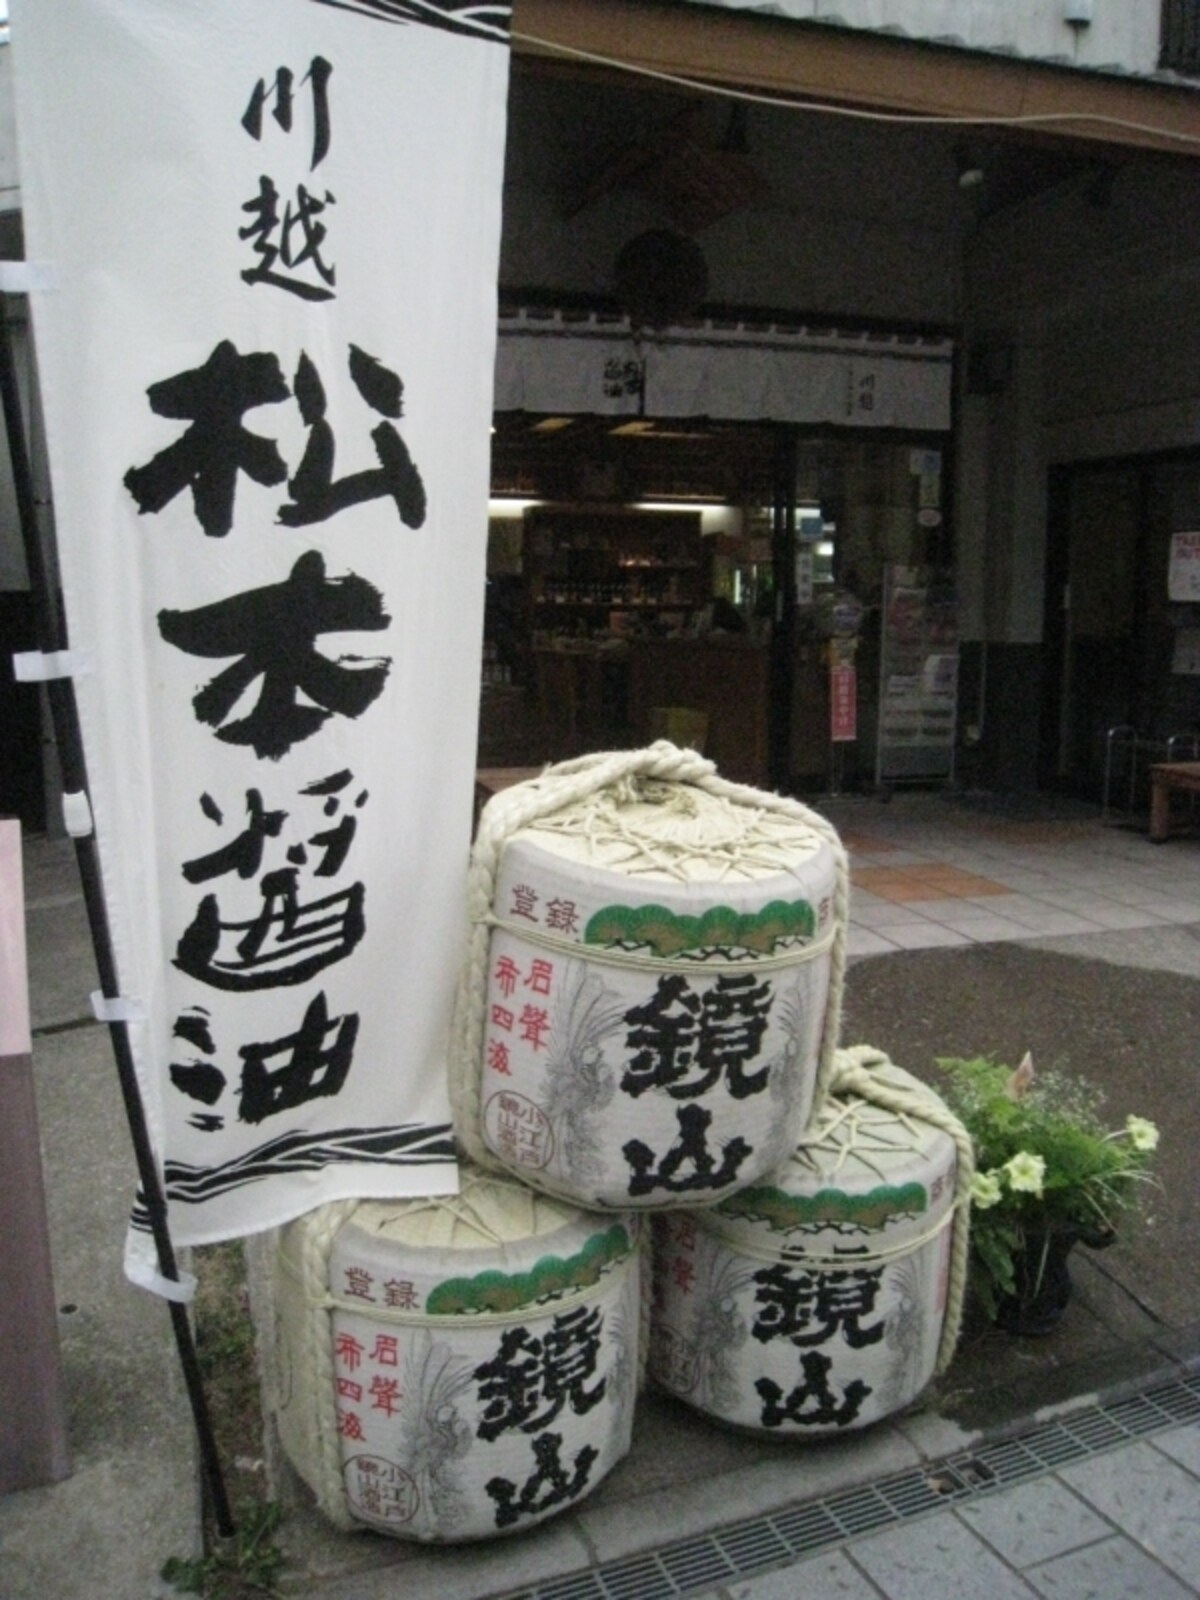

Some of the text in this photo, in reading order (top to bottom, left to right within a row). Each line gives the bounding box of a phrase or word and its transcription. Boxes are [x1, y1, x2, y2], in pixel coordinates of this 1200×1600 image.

[240, 55, 336, 301] 川越
[123, 339, 427, 1132] 松本醤油
[509, 884, 580, 935] 登録
[620, 973, 776, 1197] 鏡山
[343, 1267, 421, 1310] 登録
[752, 1244, 886, 1427] 鏡山
[472, 1305, 607, 1528] 鏡山
